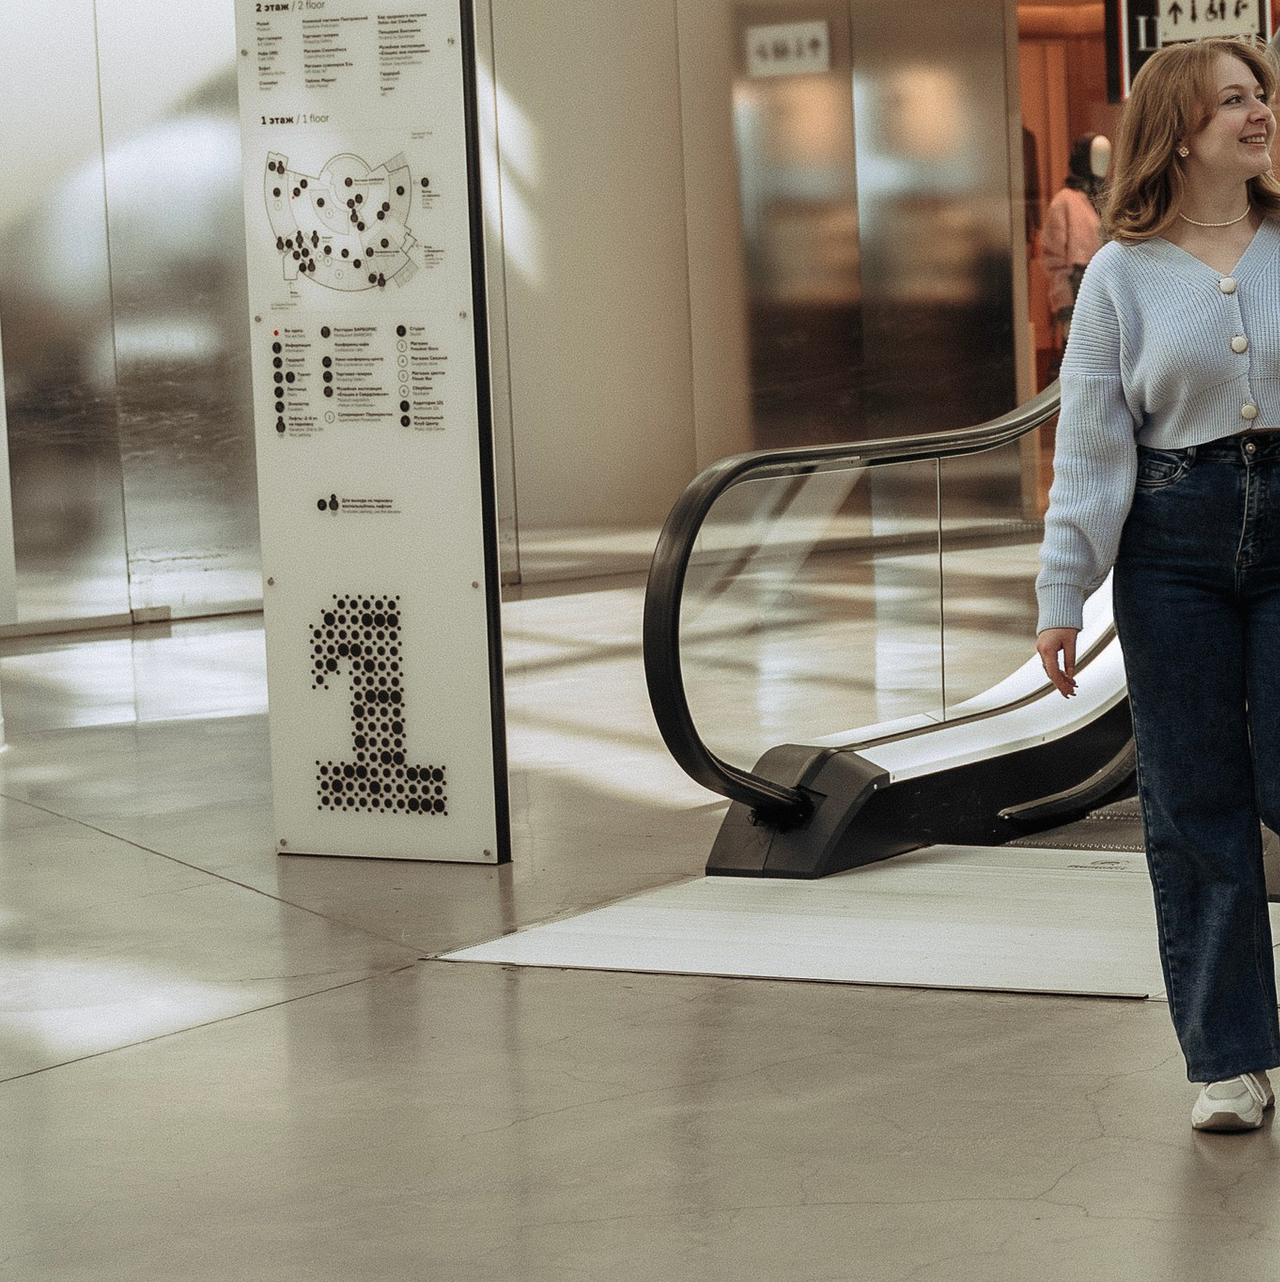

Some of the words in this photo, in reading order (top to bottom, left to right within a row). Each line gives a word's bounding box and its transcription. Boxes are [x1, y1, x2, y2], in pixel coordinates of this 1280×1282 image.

[256, 3, 262, 12] 2
[264, 3, 289, 11] этаж
[306, 0, 325, 9] floor
[261, 116, 266, 125] 1
[310, 114, 329, 123] floor
